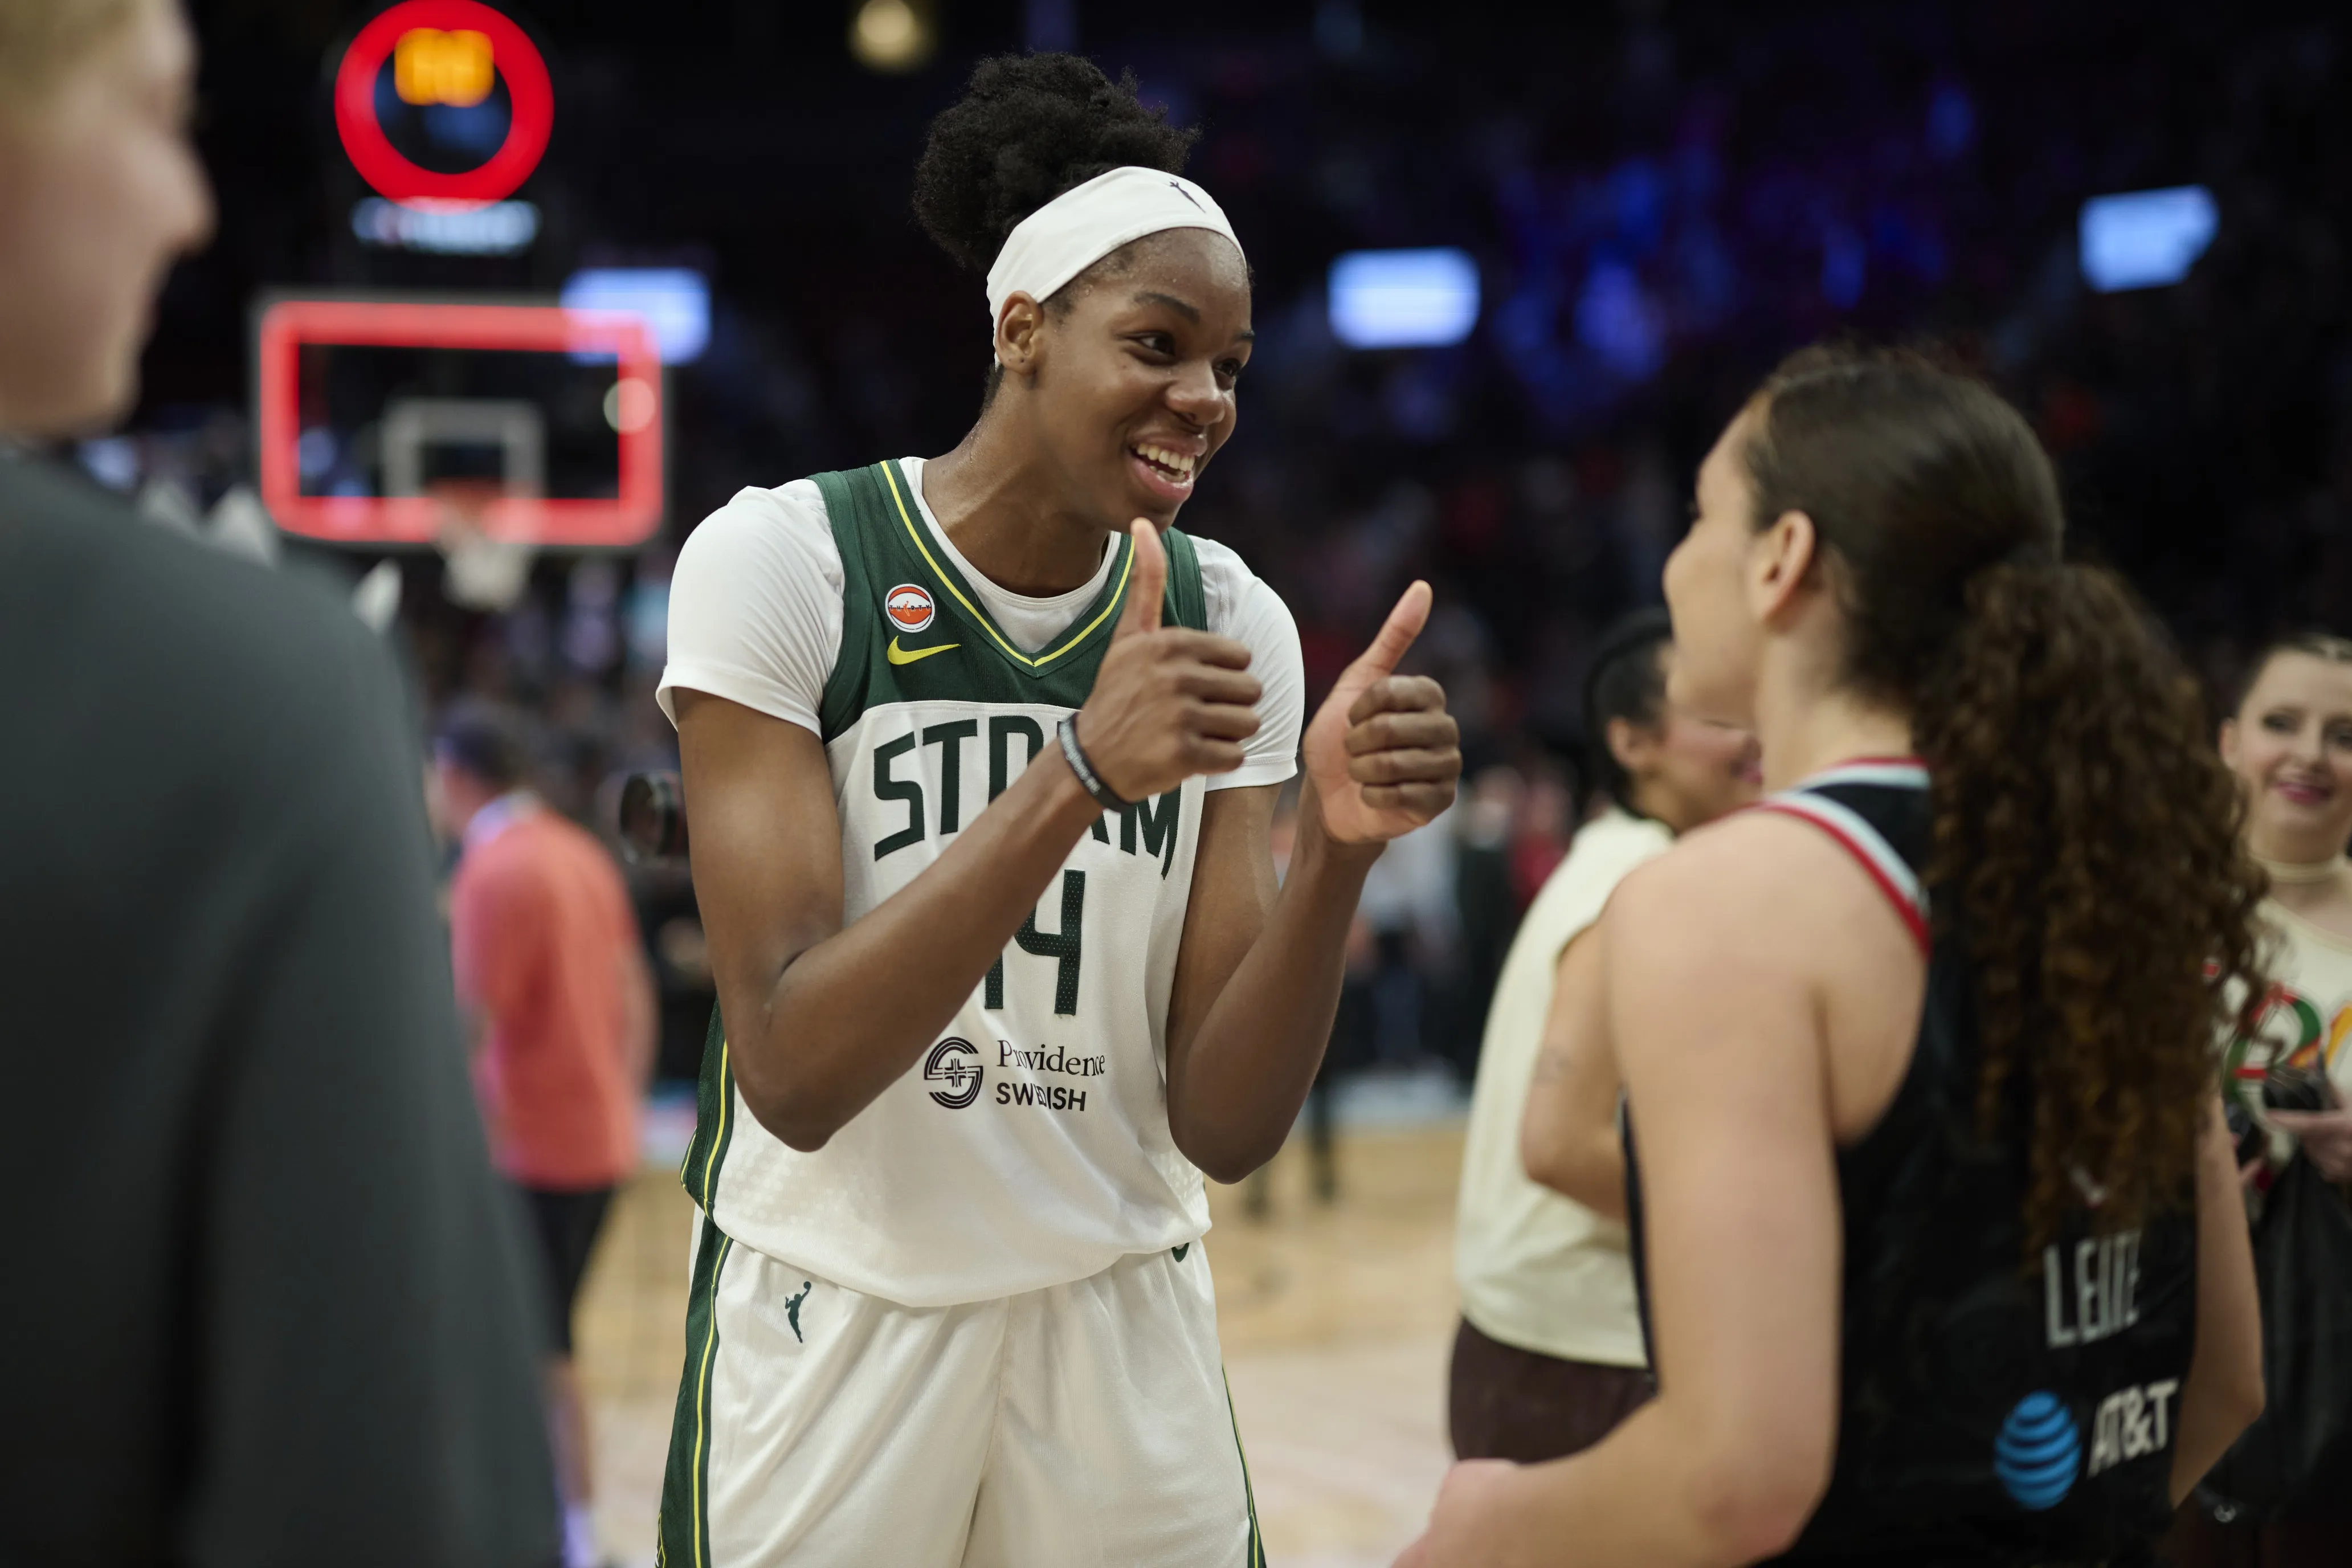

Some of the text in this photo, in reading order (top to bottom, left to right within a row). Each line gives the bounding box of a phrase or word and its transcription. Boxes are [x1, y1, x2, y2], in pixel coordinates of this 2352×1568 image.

[873, 715, 1182, 881] STOM
[996, 1040, 1105, 1076] Providence
[2087, 1377, 2179, 1479] AT&T
